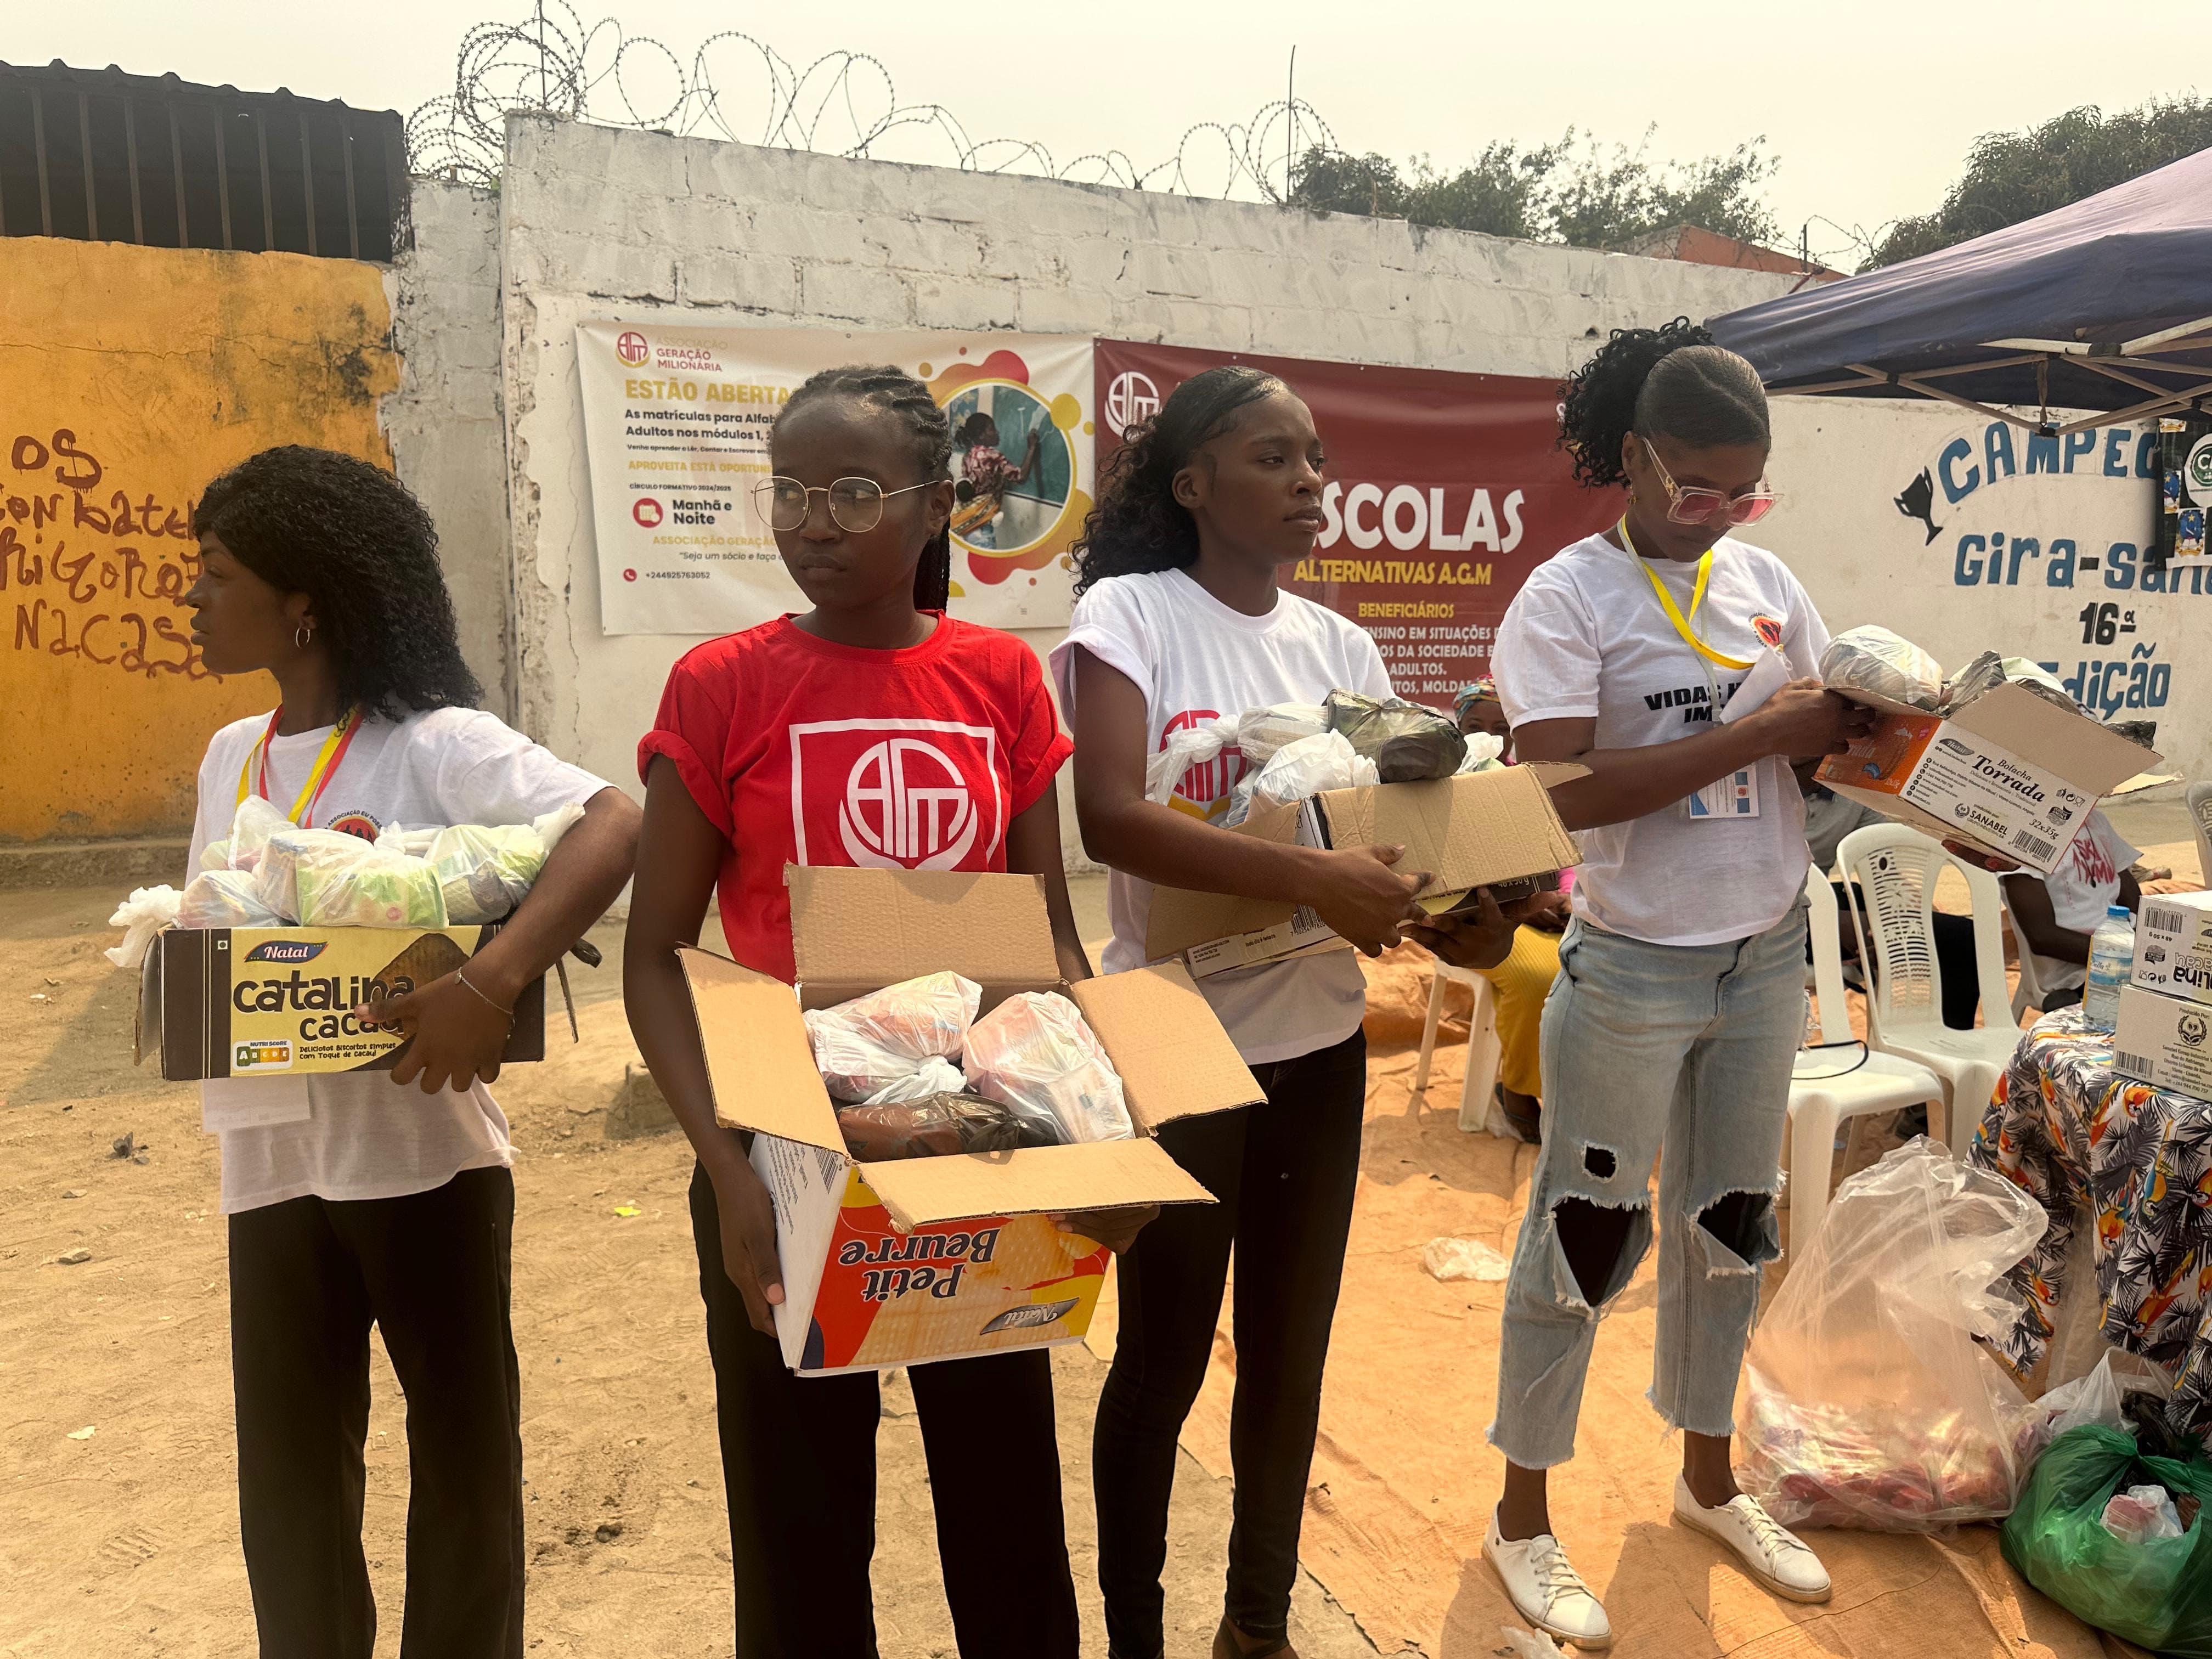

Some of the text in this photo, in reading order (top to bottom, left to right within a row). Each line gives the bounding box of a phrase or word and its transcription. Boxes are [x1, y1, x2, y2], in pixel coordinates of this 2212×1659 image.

[657, 347, 712, 361] GERAÇÃO
[658, 359, 723, 373] MILIONÁRIA
[625, 377, 793, 405] ESTÃO ABERTA
[625, 409, 640, 419] As
[643, 409, 712, 422] matrículas
[714, 413, 743, 425] para
[626, 426, 674, 437] Adultos
[676, 429, 699, 438] nos
[701, 428, 754, 440] módulos
[12, 428, 102, 493] OS
[673, 499, 732, 511] Manhã e
[674, 512, 715, 525] Noite
[1314, 481, 1525, 554] SCOLAS
[653, 535, 725, 548] ASSOCIAÇÃO
[723, 552, 747, 561] sócio
[757, 552, 777, 562] faça
[1294, 560, 1435, 585] ALTERNATIVAS
[1358, 600, 1454, 618] BENEFICIÁRIOS
[1409, 627, 1426, 640] EM
[1429, 624, 1491, 642] SITUAÇÕES
[1378, 645, 1394, 658] OS
[1397, 645, 1415, 658] DA
[1417, 645, 1485, 658] SOCIEDADE
[1389, 662, 1447, 676] ADULTOS.
[1644, 685, 1721, 710] VIDAS
[1972, 754, 2046, 802] Torrada
[1997, 759, 2032, 781] Bolacha
[1970, 810, 2008, 836] SANABEL
[2029, 819, 2059, 840] 32x35g
[263, 945, 309, 959] Natal
[233, 969, 415, 1013] catalina
[239, 1051, 248, 1060] A
[838, 1227, 1001, 1265] Beurre
[862, 1263, 966, 1302] Petit
[1003, 1306, 1058, 1327] Natal
